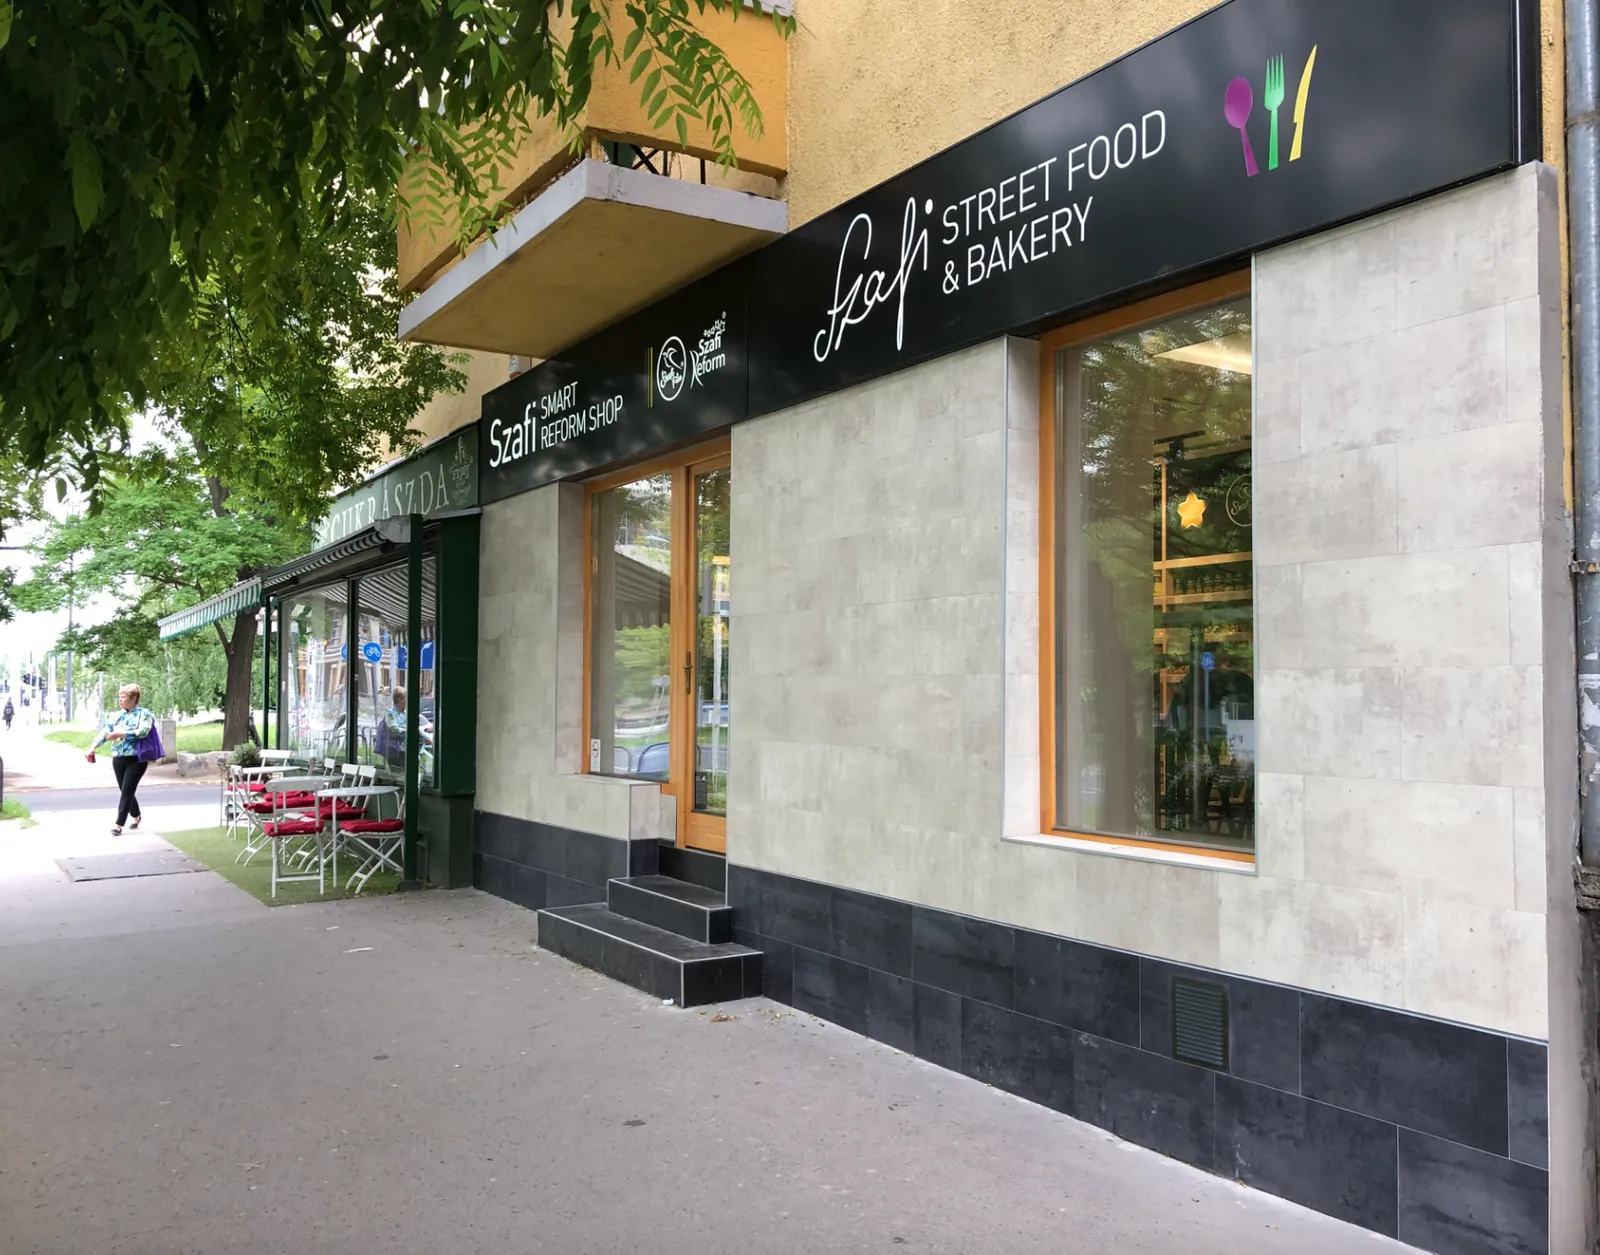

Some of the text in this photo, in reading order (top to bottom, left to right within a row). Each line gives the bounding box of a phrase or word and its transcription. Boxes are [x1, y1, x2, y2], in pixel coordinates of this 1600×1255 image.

[941, 109, 1167, 245] STREET FOOD
[941, 195, 1094, 295] & BAKERY
[689, 349, 726, 390] Reform
[698, 330, 722, 357] Szafi
[540, 381, 579, 420] SMART
[540, 394, 624, 450] REFORM SHOP
[489, 400, 537, 468] Szafi
